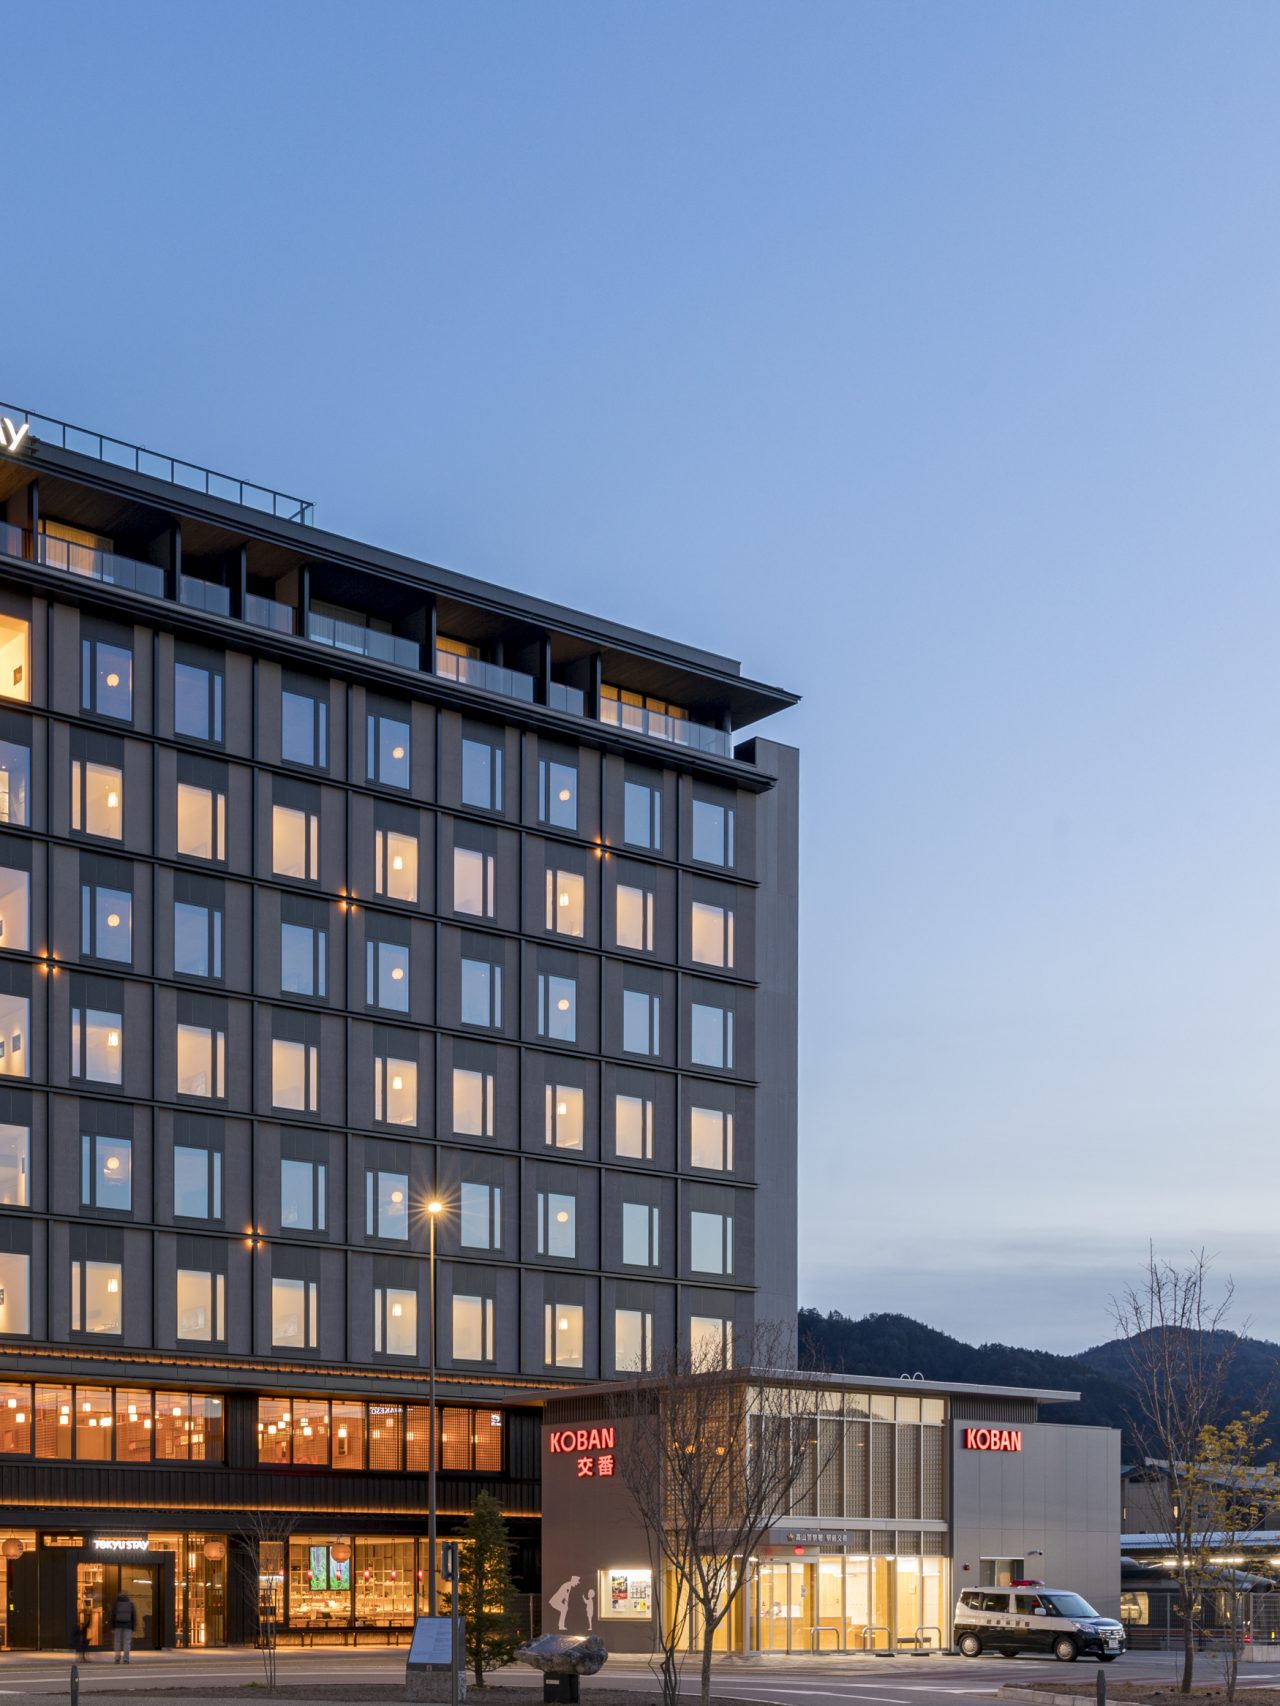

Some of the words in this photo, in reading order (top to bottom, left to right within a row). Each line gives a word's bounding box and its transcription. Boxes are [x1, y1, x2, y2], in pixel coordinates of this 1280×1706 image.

[550, 1427, 614, 1453] KOBAN
[967, 1428, 1022, 1451] KOBAN
[577, 1454, 614, 1477] 交番
[94, 1540, 125, 1550] TOKYU
[126, 1540, 149, 1550] STAY
